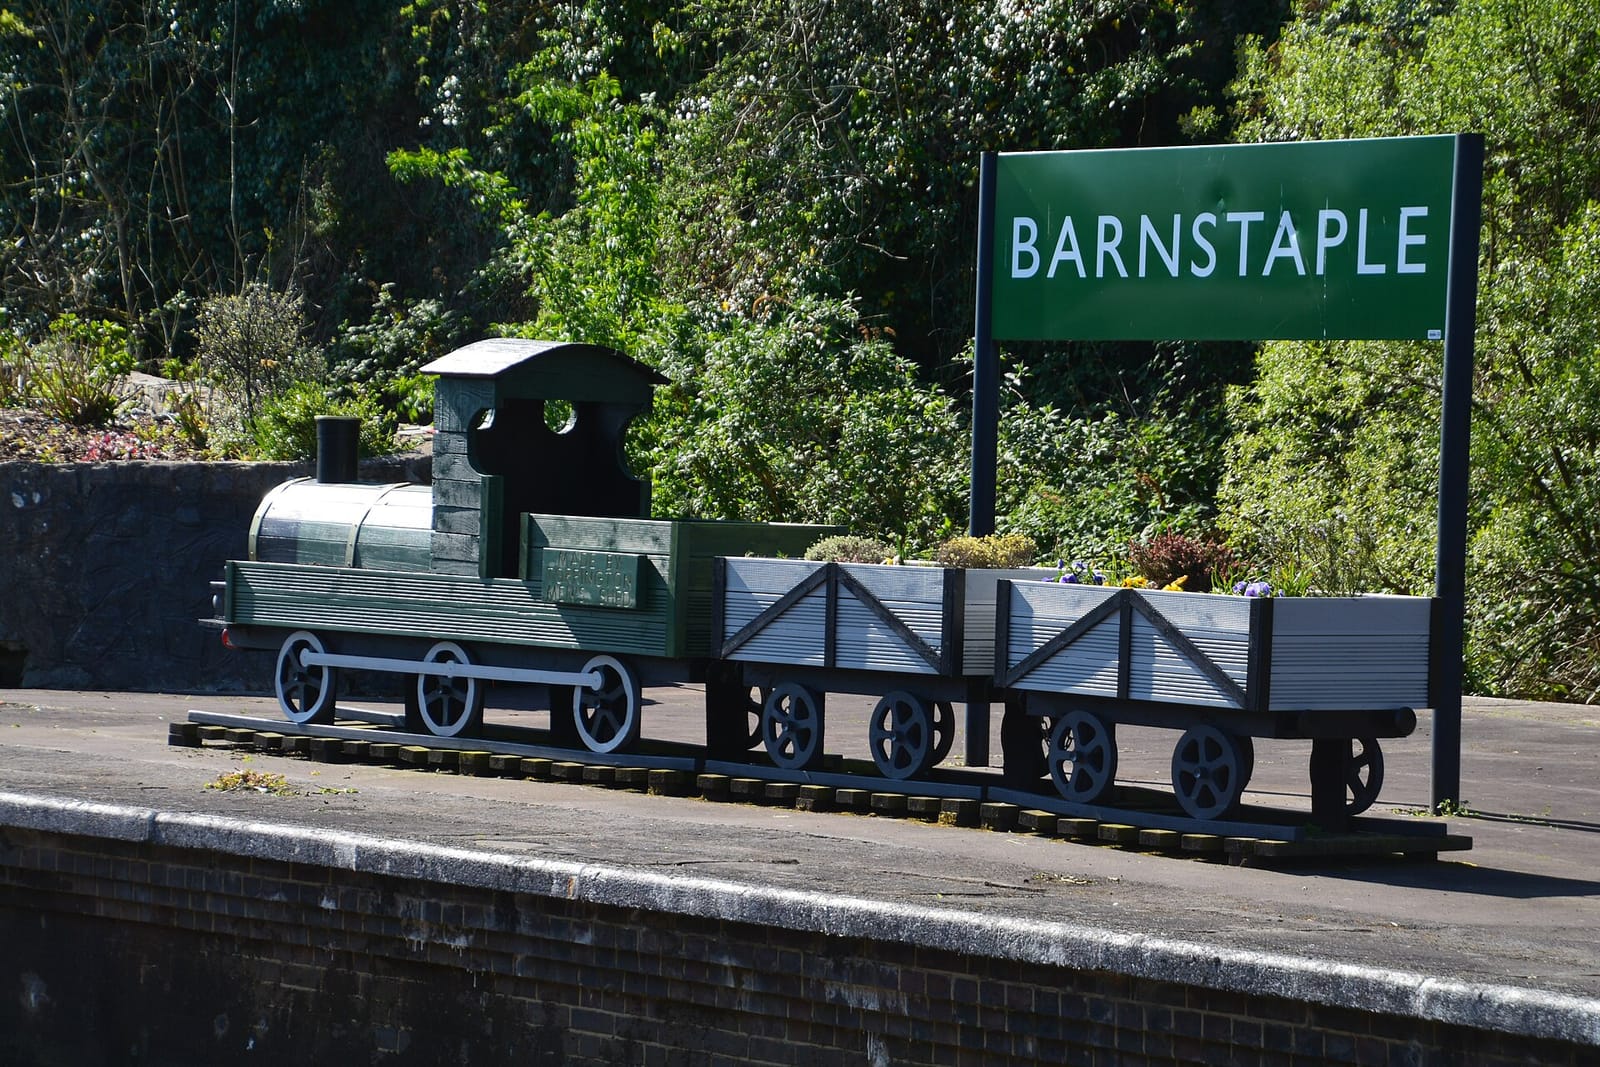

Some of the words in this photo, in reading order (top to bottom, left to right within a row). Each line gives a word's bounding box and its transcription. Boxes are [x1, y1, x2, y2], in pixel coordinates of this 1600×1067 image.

[1011, 206, 1429, 279] BARNSTAPLE
[556, 551, 596, 570] MADE
[605, 553, 621, 571] BY
[547, 567, 632, 591] TORRINGTON
[599, 588, 632, 608] SHED
